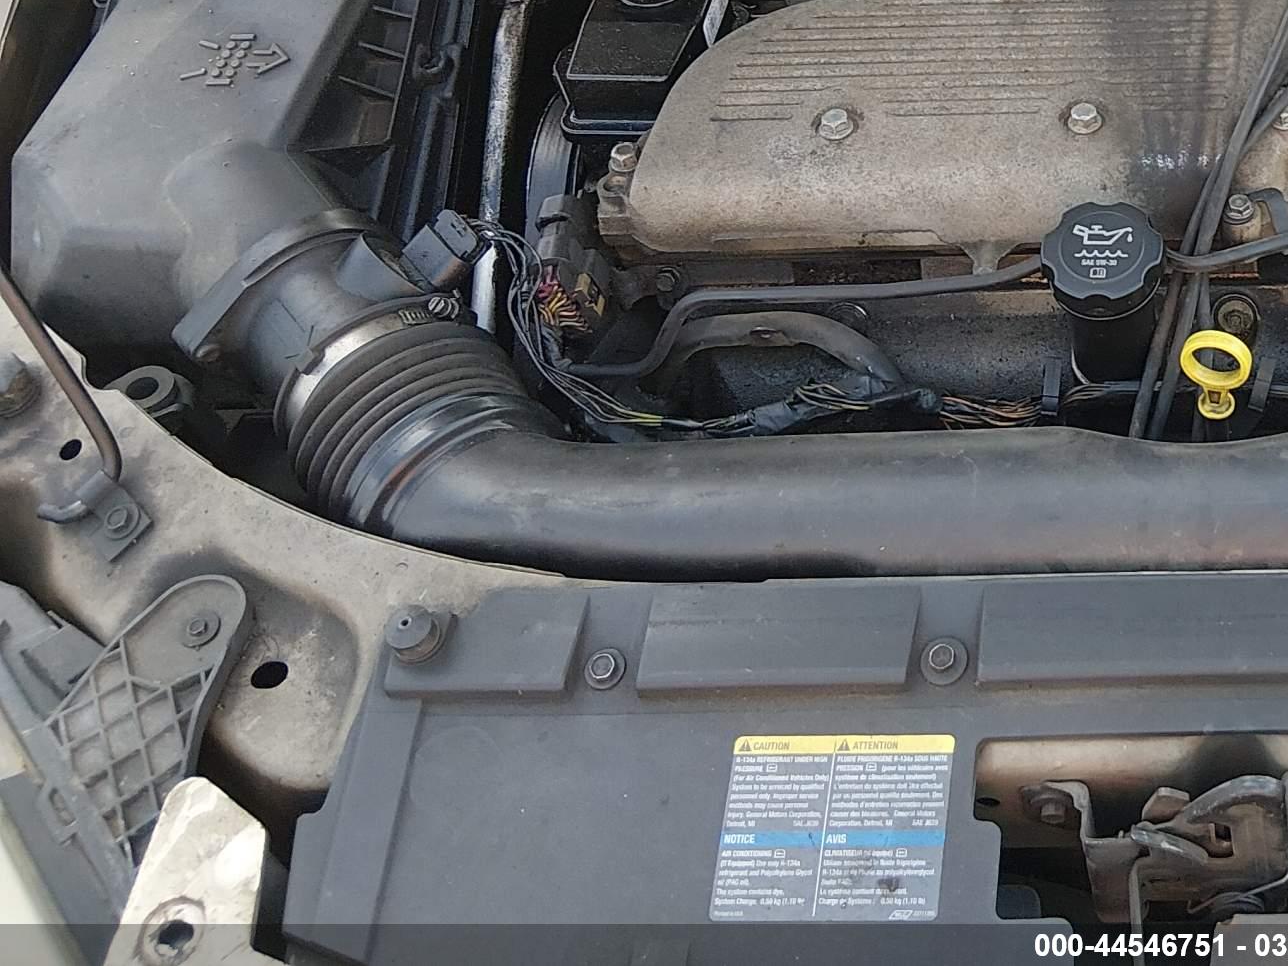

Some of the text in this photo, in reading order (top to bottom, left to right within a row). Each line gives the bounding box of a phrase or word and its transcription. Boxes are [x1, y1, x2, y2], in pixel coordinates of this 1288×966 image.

[1081, 258, 1095, 266] SAE
[753, 741, 790, 751] CAUTION
[852, 740, 898, 750] ATTENTION
[724, 834, 755, 844] NOTICE
[826, 834, 847, 843] AVIS
